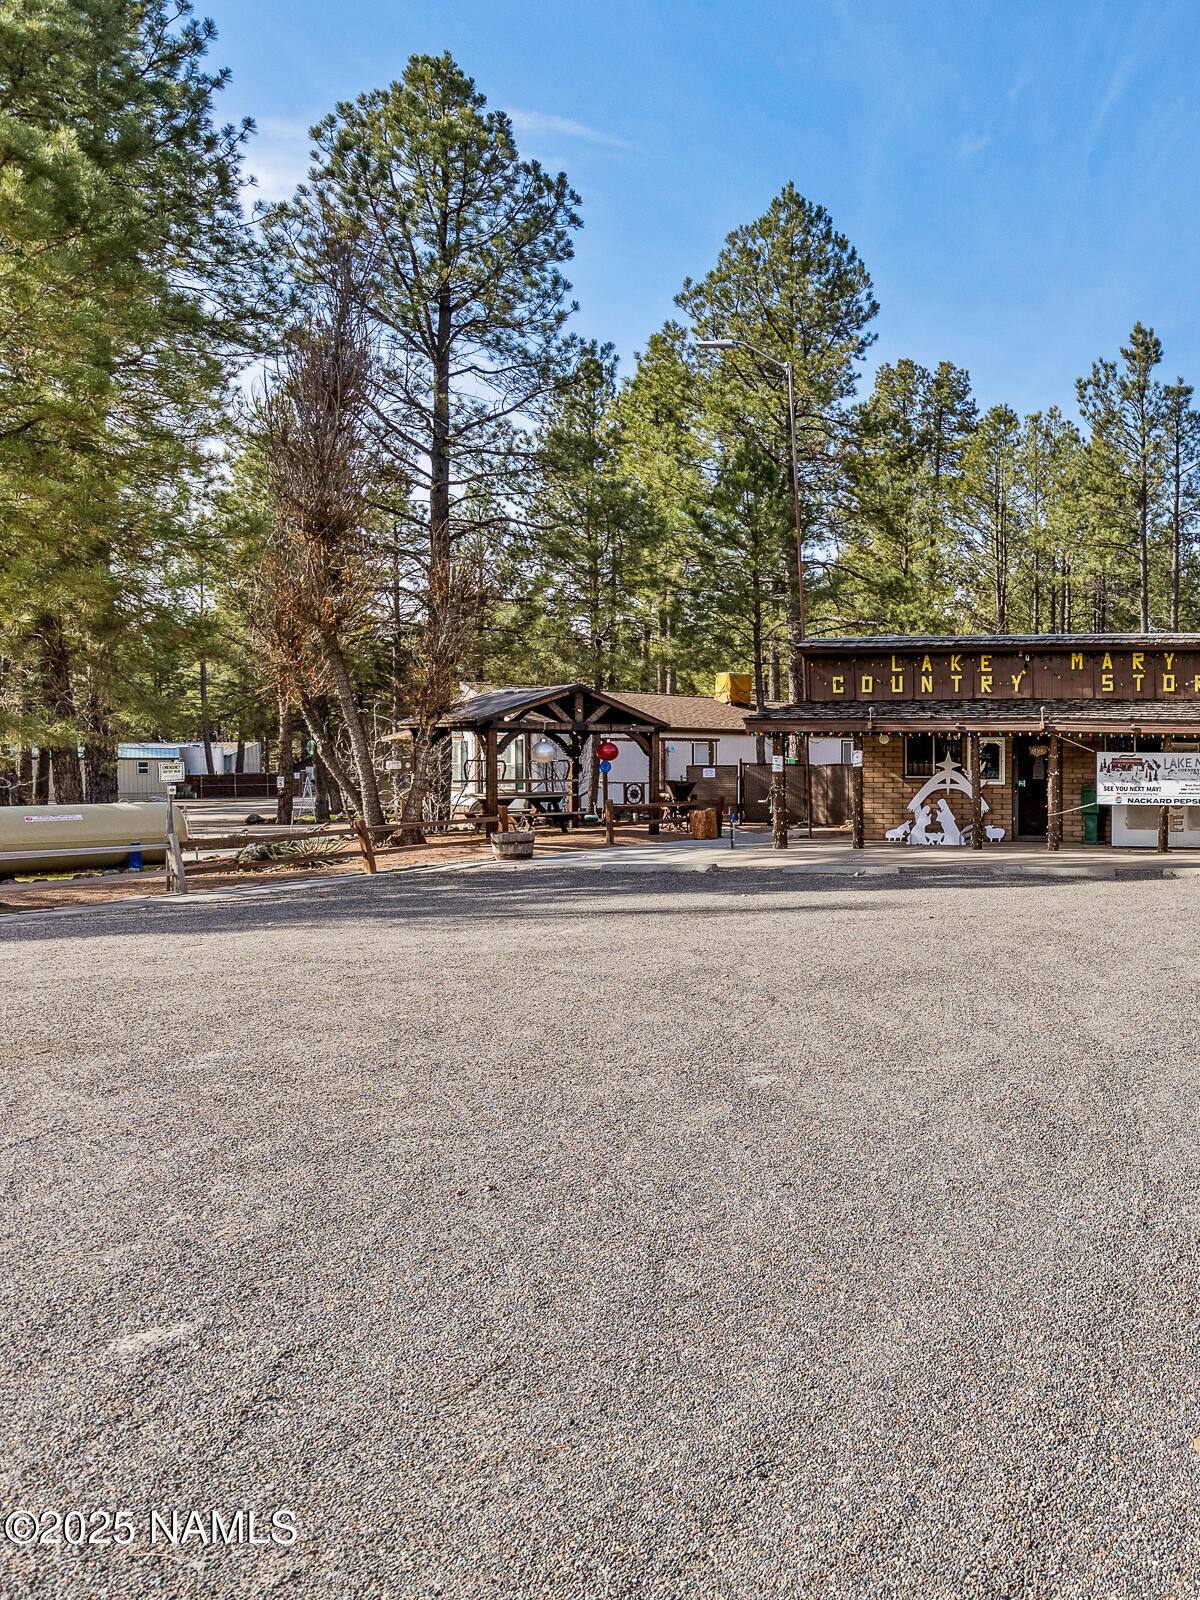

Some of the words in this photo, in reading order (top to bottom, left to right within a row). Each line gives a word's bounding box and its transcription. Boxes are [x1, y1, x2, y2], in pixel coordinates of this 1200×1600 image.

[891, 654, 992, 672] LAKE
[1071, 652, 1174, 670] MARY
[832, 675, 1022, 693] COUNTRY
[1164, 757, 1192, 770] LAKE
